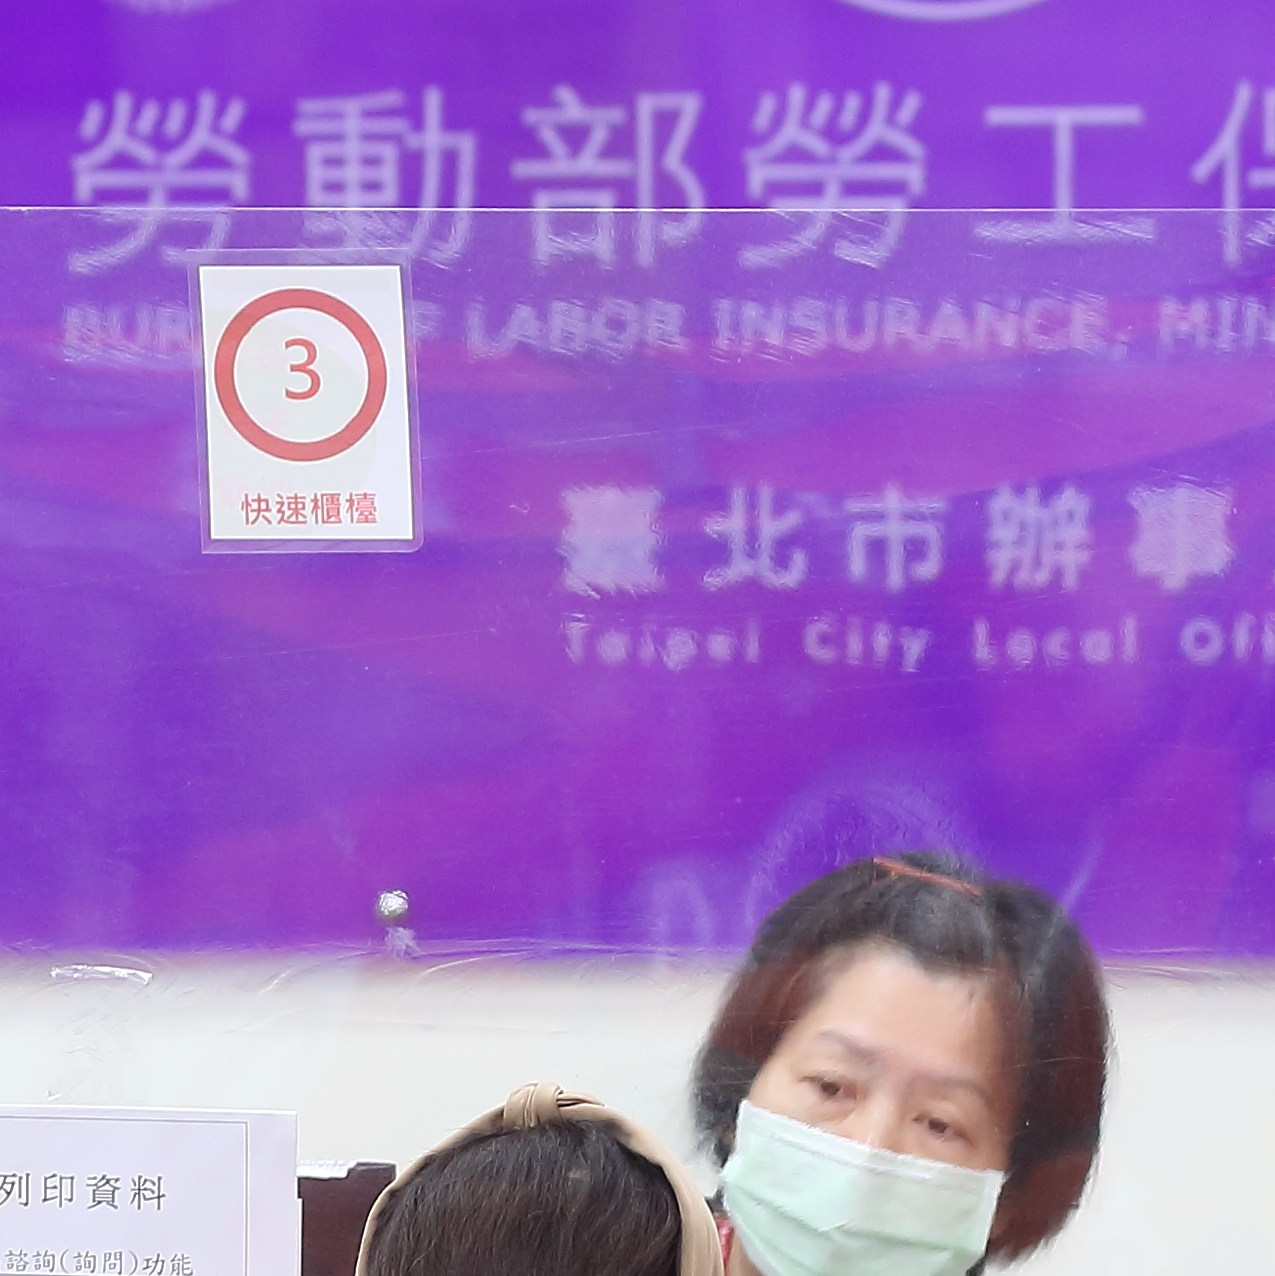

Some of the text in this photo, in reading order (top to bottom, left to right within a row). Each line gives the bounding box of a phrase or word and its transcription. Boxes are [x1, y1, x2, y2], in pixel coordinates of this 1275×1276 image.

[467, 300, 688, 358] LABOR
[283, 337, 322, 401] 3
[240, 491, 378, 526] 快速櫃檯
[562, 613, 760, 670] Taipei
[803, 613, 930, 671] City
[972, 616, 1138, 667] Local
